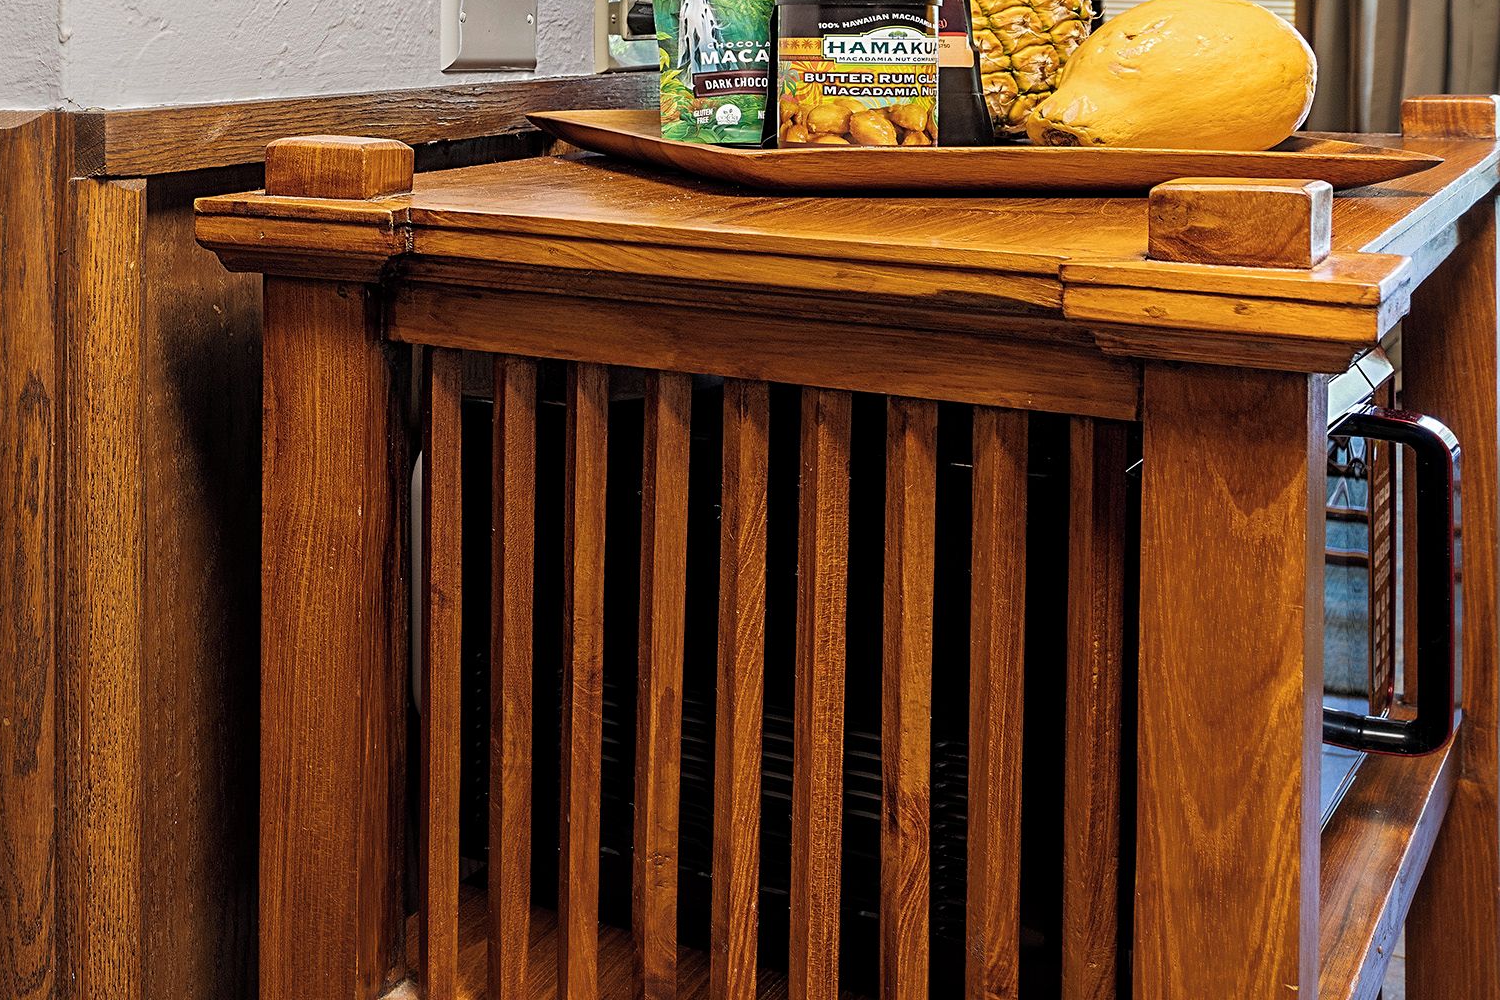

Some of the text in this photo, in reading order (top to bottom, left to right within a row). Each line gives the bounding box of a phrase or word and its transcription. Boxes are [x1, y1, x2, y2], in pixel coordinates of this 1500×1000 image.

[818, 22, 840, 30] 100%
[842, 13, 890, 29] HAWAIIAN
[891, 13, 933, 29] MACADAMIA
[707, 40, 771, 50] CHOCOLA
[701, 49, 769, 65] MACA
[705, 77, 768, 90] DARK CHOCO
[804, 73, 874, 84] BUTTER
[879, 73, 915, 84] RUM
[823, 85, 919, 97] MACADAMIA
[693, 108, 714, 118] GLUTEN
[696, 116, 710, 125] FREE
